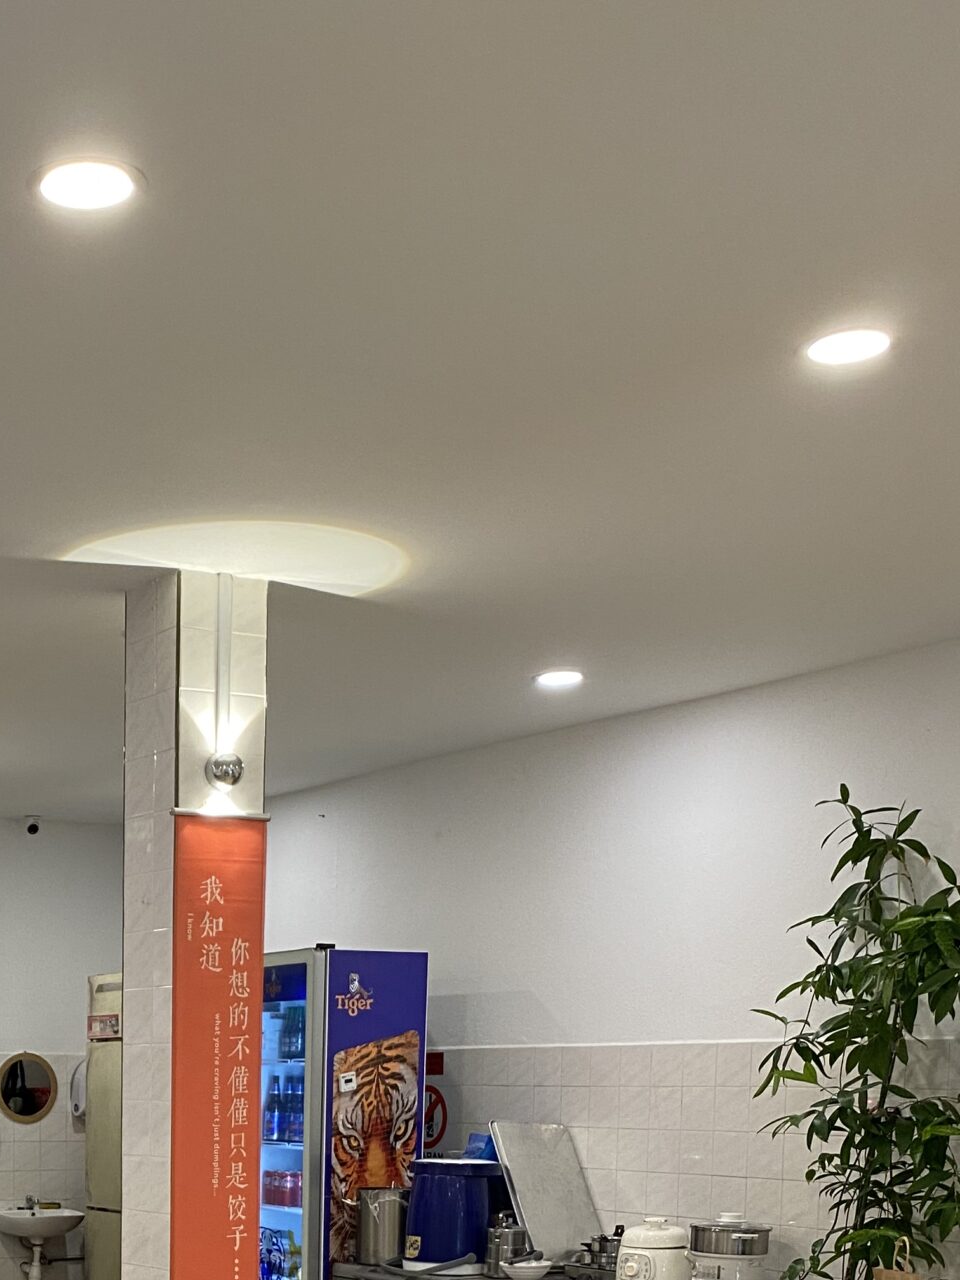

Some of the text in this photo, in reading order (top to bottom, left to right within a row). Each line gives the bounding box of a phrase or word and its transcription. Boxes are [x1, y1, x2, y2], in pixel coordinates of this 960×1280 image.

[199, 875, 224, 973] 我知道
[335, 994, 373, 1016] Tiger
[213, 1037, 221, 1065] you're
[212, 1068, 220, 1100] craving
[212, 1123, 220, 1141] just
